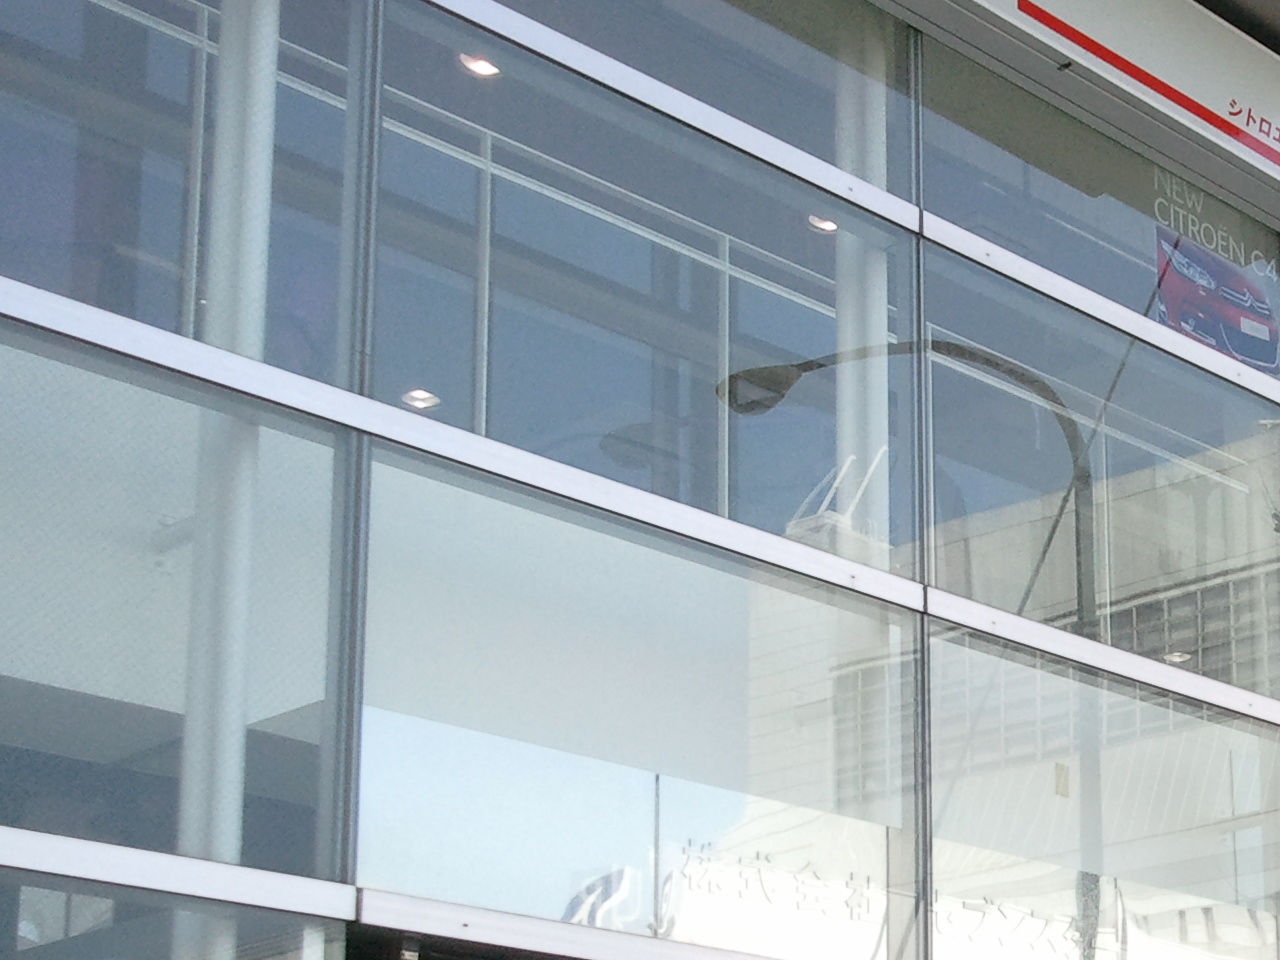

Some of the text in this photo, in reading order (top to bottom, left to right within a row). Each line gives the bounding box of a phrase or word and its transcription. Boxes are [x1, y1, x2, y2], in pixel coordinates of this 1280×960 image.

[1153, 167, 1205, 214] NEW
[1154, 197, 1277, 277] CITROËN C4
